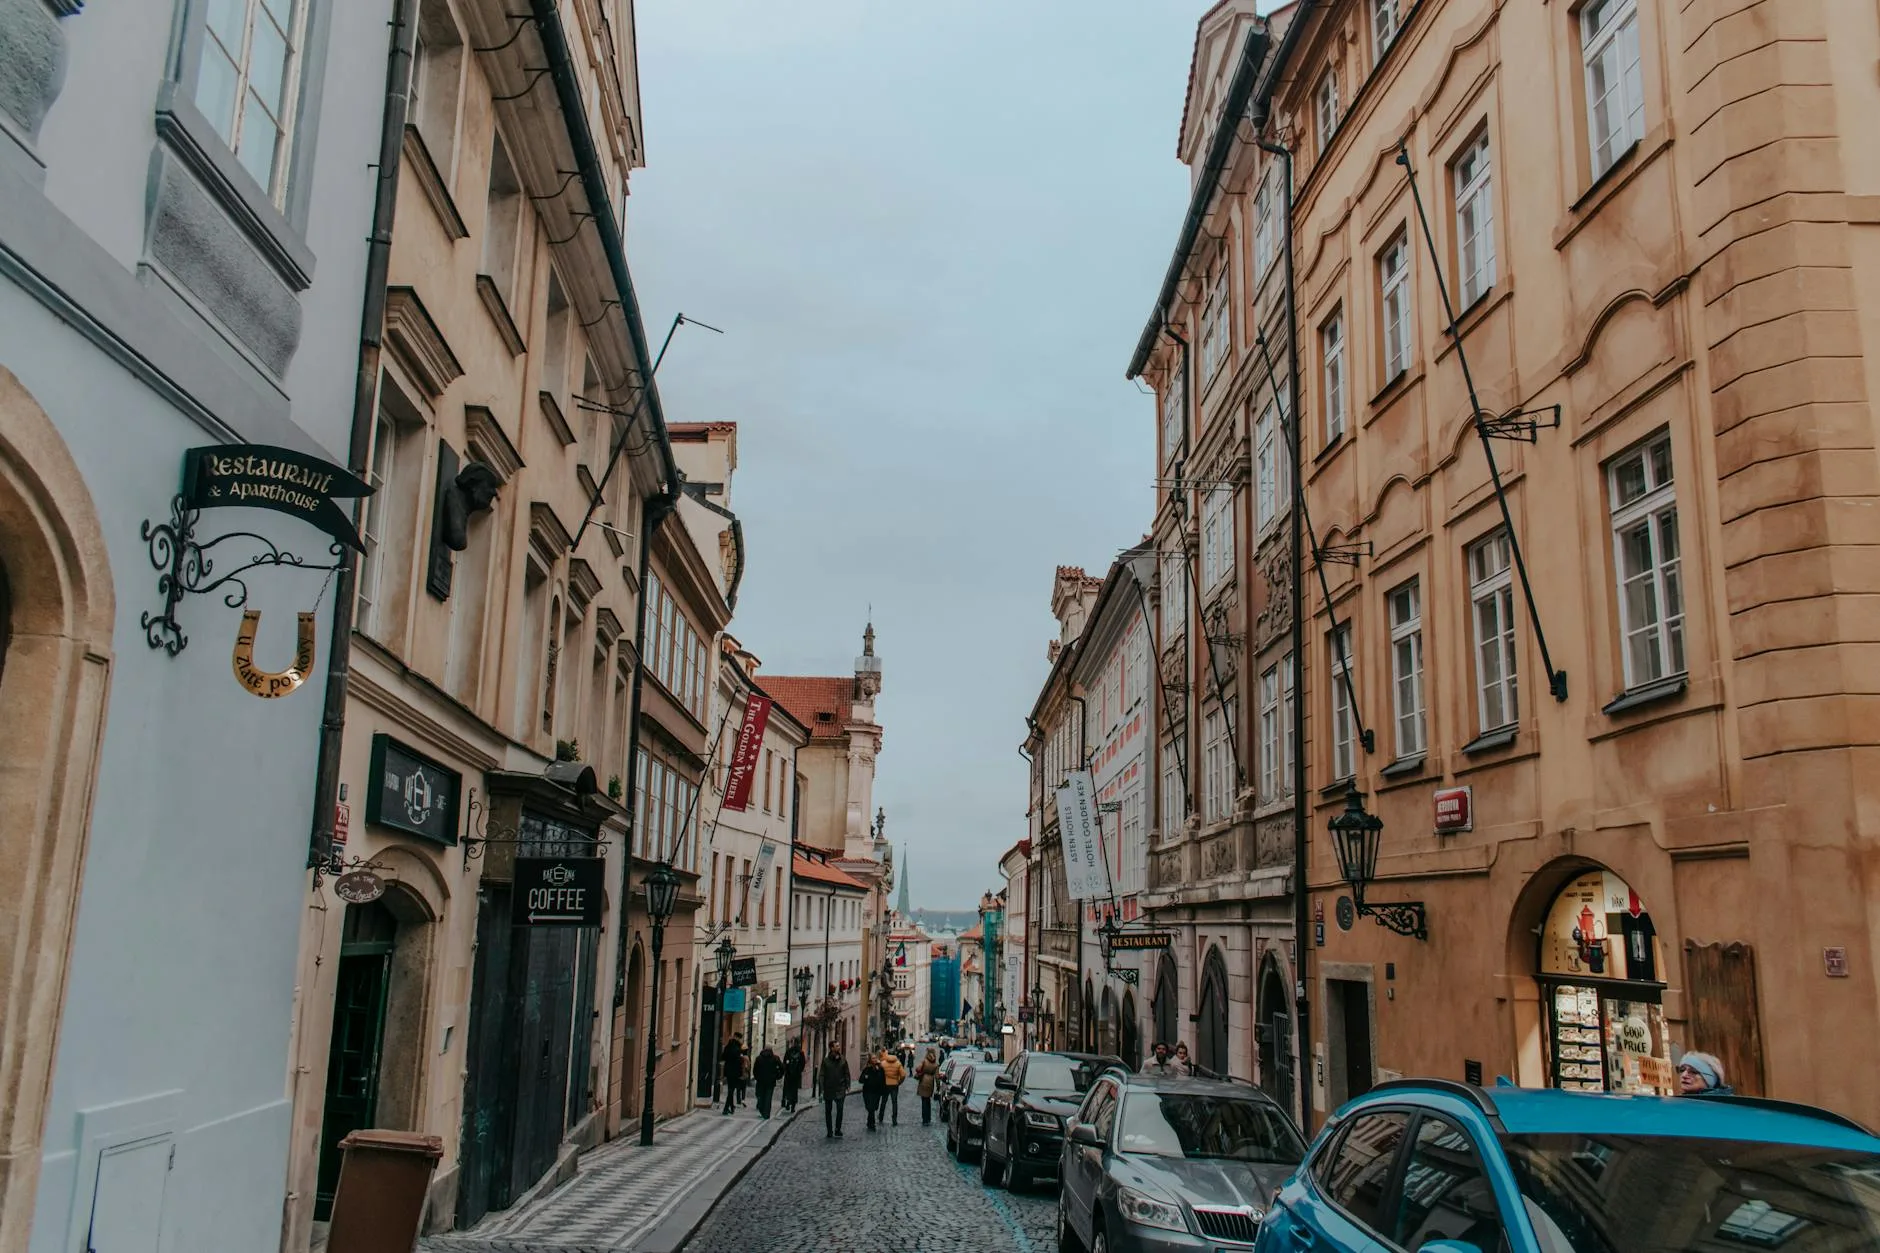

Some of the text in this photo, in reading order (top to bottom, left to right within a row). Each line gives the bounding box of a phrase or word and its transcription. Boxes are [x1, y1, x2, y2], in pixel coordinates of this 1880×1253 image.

[208, 485, 222, 497] &
[1064, 806, 1075, 837] HOTELS
[1077, 779, 1095, 868] HOTEL GOLDEN KEY
[528, 888, 586, 910] COFFEE
[1110, 935, 1169, 948] RESTAURANT
[1623, 1025, 1645, 1039] GOOD
[1623, 1040, 1648, 1053] PRICE
